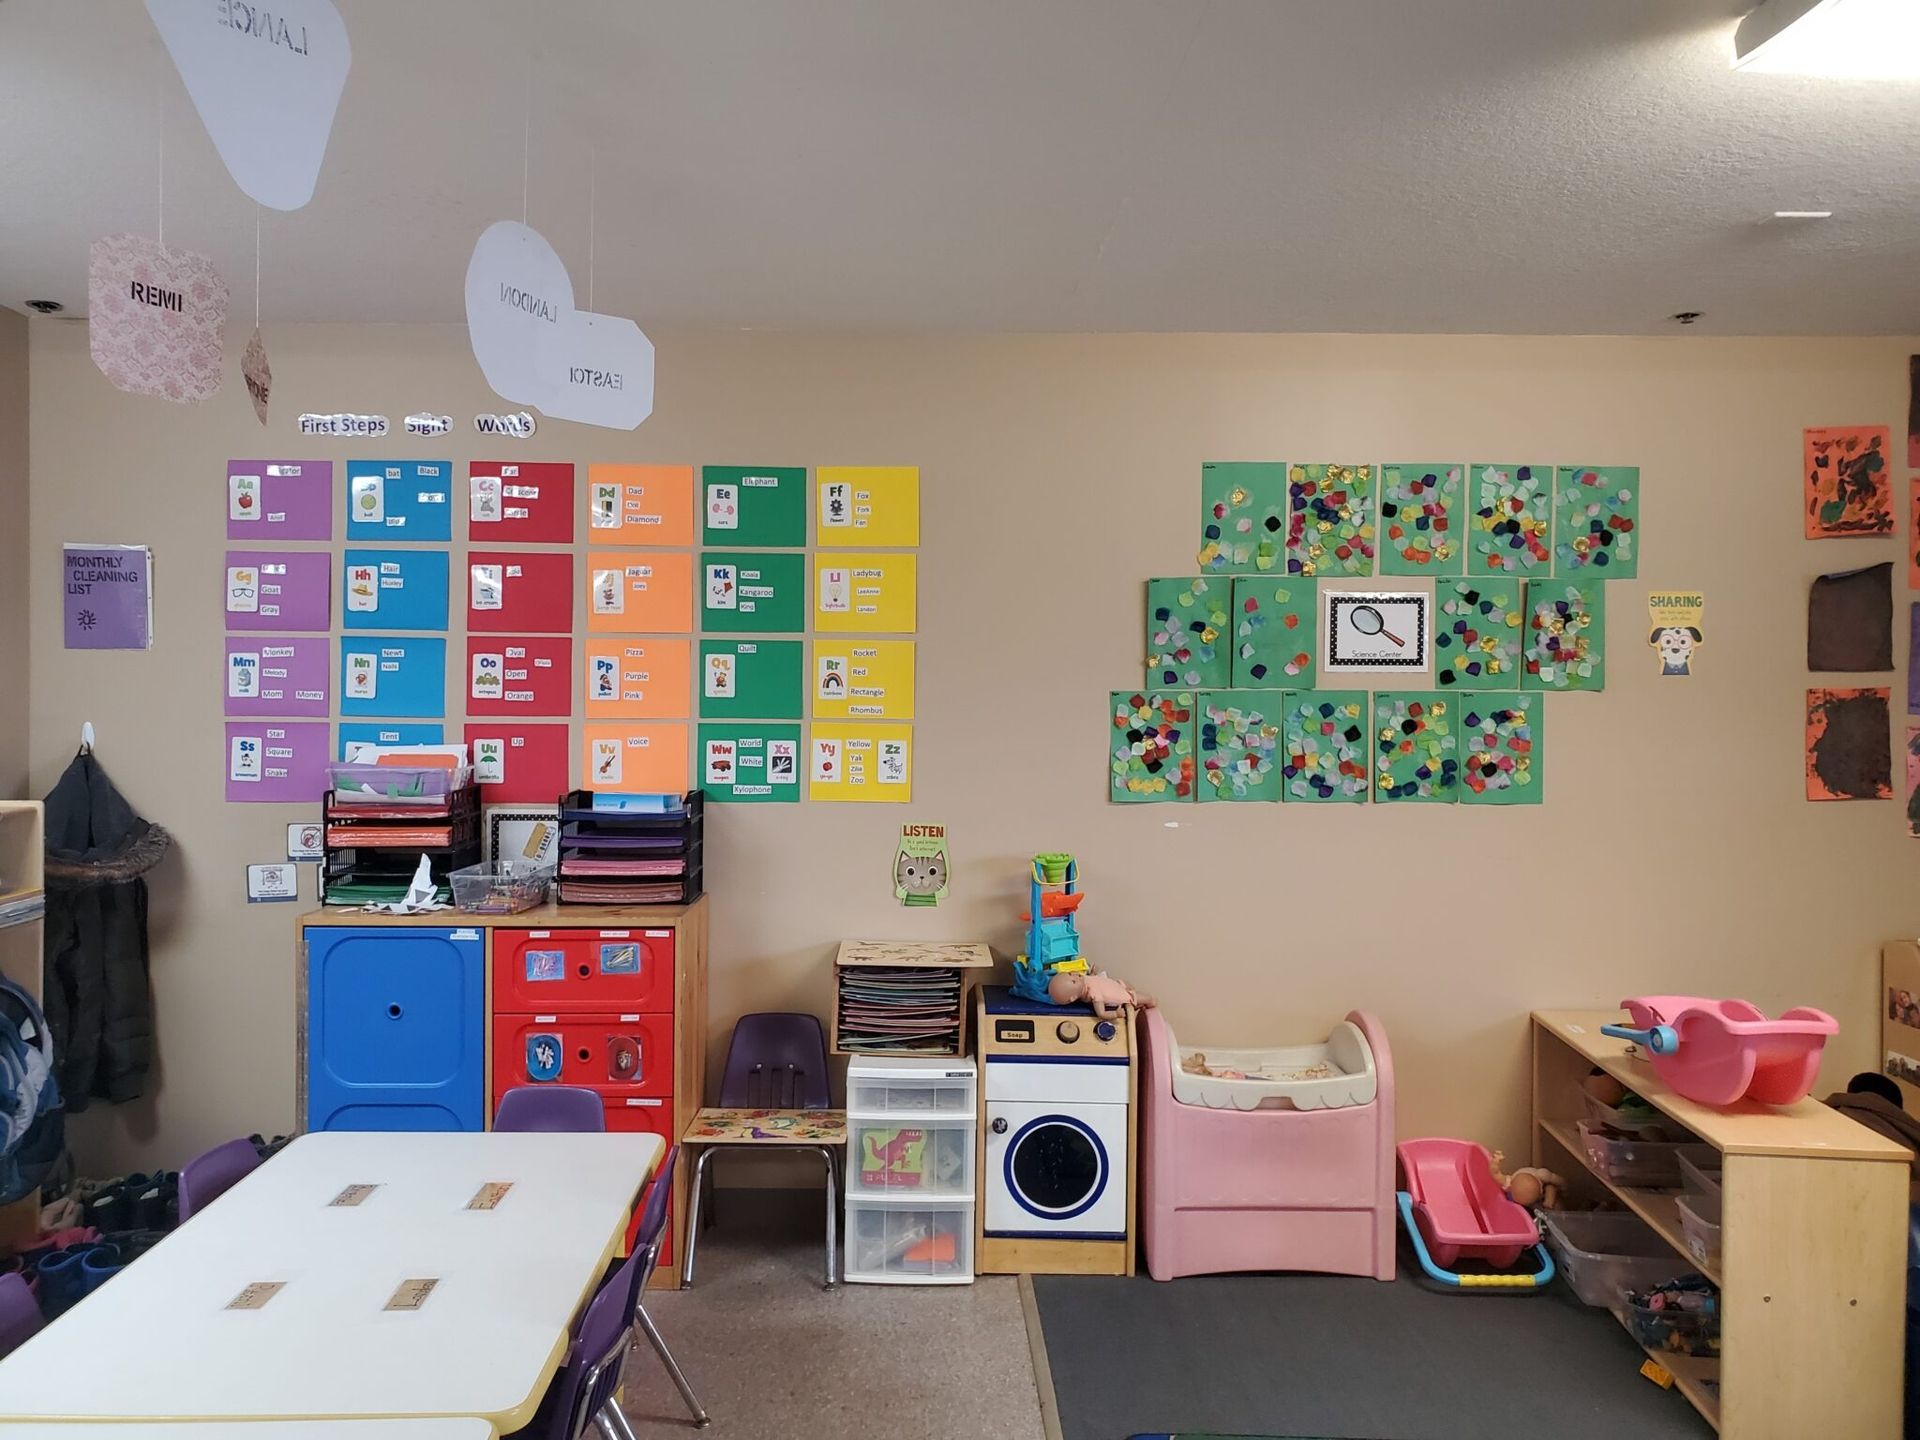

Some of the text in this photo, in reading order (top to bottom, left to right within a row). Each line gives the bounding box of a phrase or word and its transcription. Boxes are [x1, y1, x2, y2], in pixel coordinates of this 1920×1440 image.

[131, 281, 182, 313] REMI
[301, 417, 531, 436] First Steps Sight Words
[420, 467, 438, 475] Black
[238, 479, 254, 490] Aa
[599, 487, 616, 498] Dd
[716, 489, 731, 499] Ee
[830, 485, 844, 498] Ff
[627, 515, 660, 525] Diamond
[66, 555, 123, 569] MONTHLY
[72, 570, 139, 583] CLEANING
[235, 571, 252, 585] Gg
[355, 568, 371, 581] Hh
[714, 568, 730, 580] Kk
[852, 570, 883, 578] Ladybug
[67, 583, 93, 595] LIST
[740, 588, 774, 597] Kangaroo
[1650, 595, 1703, 608] SHARING
[261, 605, 278, 614] Gray
[264, 648, 293, 657] Monkey
[1351, 650, 1403, 658] Science Center
[233, 656, 255, 668] Mm
[354, 657, 371, 669] Nn
[480, 657, 497, 668] Oo
[597, 660, 613, 674] Pp
[711, 657, 732, 671] Qq
[826, 660, 841, 671] Rr
[506, 670, 526, 679] Open
[625, 672, 648, 681] Purple
[852, 668, 866, 676] Red
[297, 692, 323, 700] Money
[507, 692, 533, 701] Orange
[624, 691, 640, 699] Pink
[850, 688, 884, 698] Rectangle
[850, 705, 883, 715] Rhombus
[268, 730, 284, 738] Star
[381, 731, 398, 740] Tent
[240, 741, 255, 752] Ss
[512, 738, 523, 746] Up
[628, 737, 649, 746] Voice
[848, 740, 871, 748] Yellow
[266, 747, 292, 757] Square
[480, 743, 498, 754] Uu
[599, 744, 616, 755] Vv
[711, 744, 732, 755] Ww
[774, 744, 791, 755] Xx
[819, 743, 836, 757] Yy
[884, 744, 902, 755] Zz
[741, 757, 763, 767] White
[850, 754, 862, 762] Yak
[850, 776, 864, 784] Zoo
[734, 785, 771, 795] Xylophone
[903, 825, 945, 838] LISTEN
[1007, 1032, 1023, 1040] Soap
